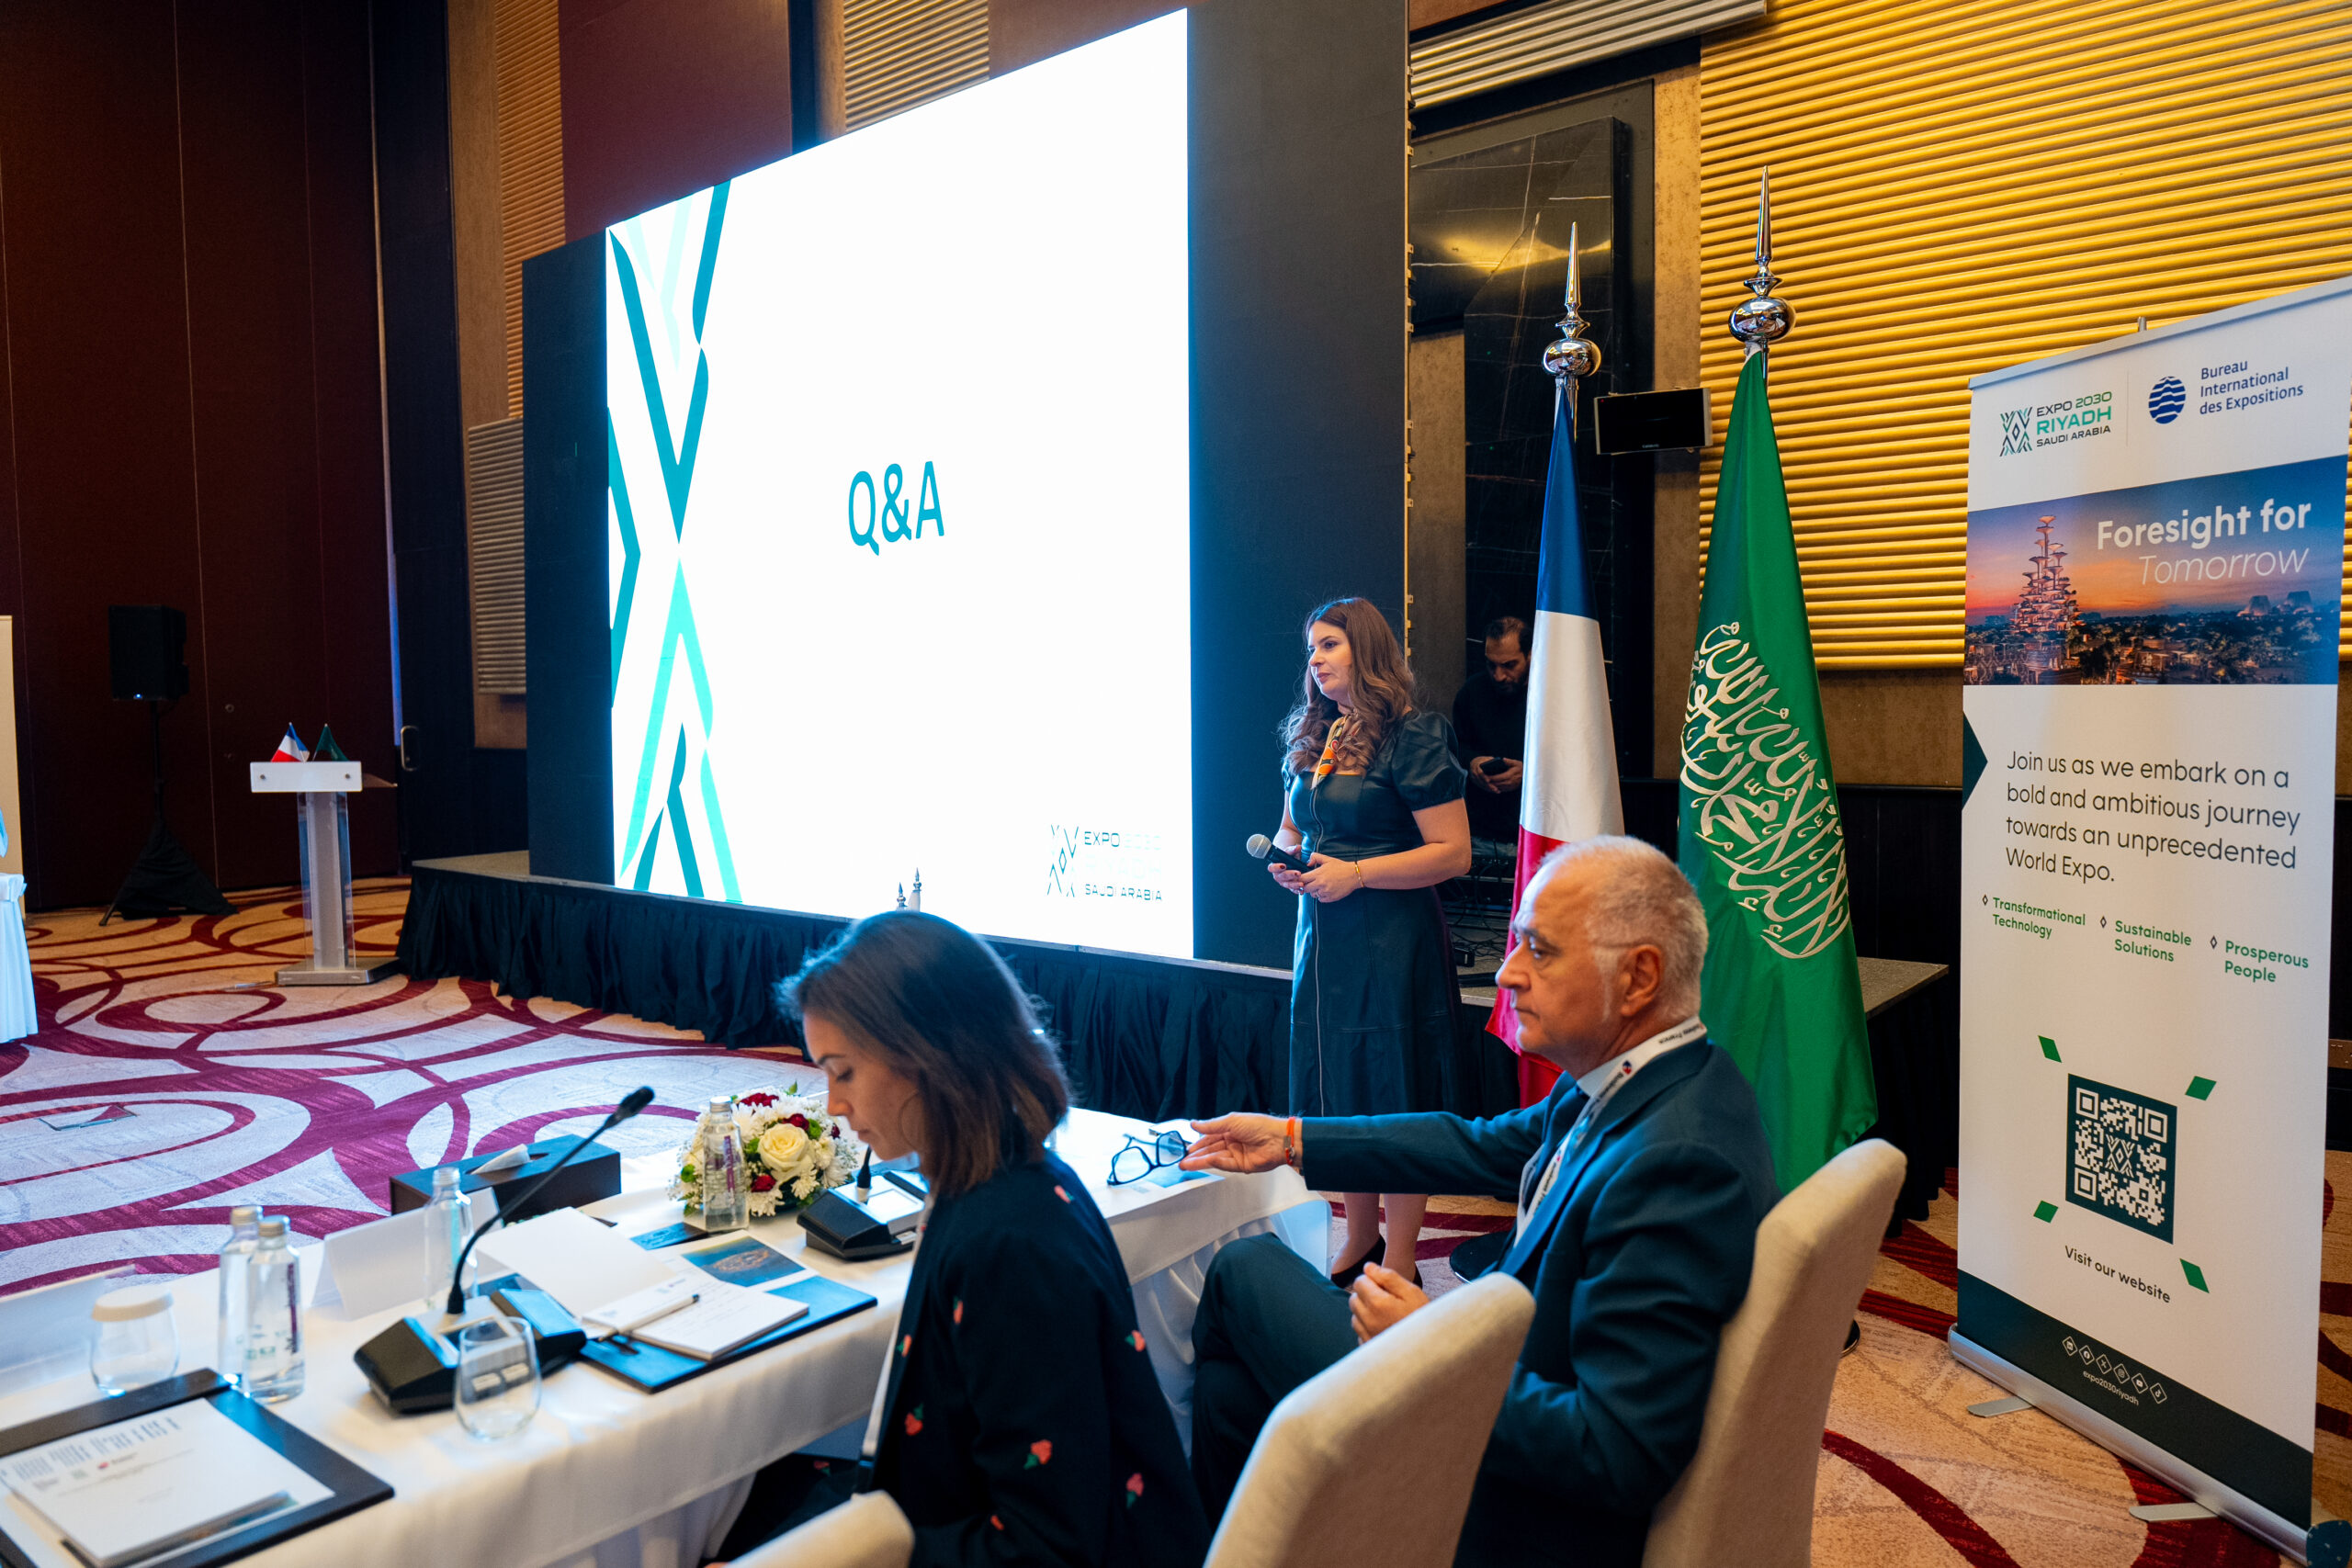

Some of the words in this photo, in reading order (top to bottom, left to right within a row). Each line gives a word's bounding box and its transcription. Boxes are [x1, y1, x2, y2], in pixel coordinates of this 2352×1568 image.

[2201, 361, 2247, 379] Bureau
[2201, 367, 2288, 397] International
[2037, 401, 2072, 417] EXPO
[2075, 391, 2111, 408] 2030
[2200, 401, 2222, 414] des
[2226, 386, 2303, 410] Expositions
[2037, 406, 2111, 434] RIYADH
[2037, 434, 2067, 446] SAUDI
[2072, 425, 2110, 439] ARABIA
[849, 461, 944, 556] Q&A
[2098, 507, 2250, 550] Foresight
[2260, 499, 2311, 532] for
[2139, 548, 2309, 584] Tomorrow
[2007, 751, 2042, 771] Join
[2049, 758, 2066, 773] us
[2072, 760, 2094, 774] as
[2101, 761, 2133, 777] we
[2141, 760, 2226, 784] embark
[2234, 769, 2265, 786] on
[2274, 771, 2289, 788] a
[2007, 783, 2045, 804] bold
[2051, 789, 2086, 808] and
[2093, 794, 2199, 819] ambitious
[2205, 799, 2301, 836] journey
[1084, 830, 1121, 848] EXPO
[2007, 817, 2076, 841] towards
[2083, 829, 2109, 845] an
[2118, 833, 2295, 869] unprecedented
[2007, 848, 2055, 873] World
[2063, 856, 2114, 883] Expo.
[1993, 897, 2085, 925] Transformational
[1993, 914, 2052, 940] Technology
[2116, 920, 2191, 945] Sustainable
[2115, 939, 2174, 962] Solutions
[2226, 941, 2308, 968] Prosperous
[2225, 961, 2276, 982] People
[2065, 1246, 2092, 1267] Visit
[2095, 1263, 2115, 1277] our
[2119, 1272, 2170, 1303] website
[2083, 1371, 2140, 1406] expo2030riyadh
